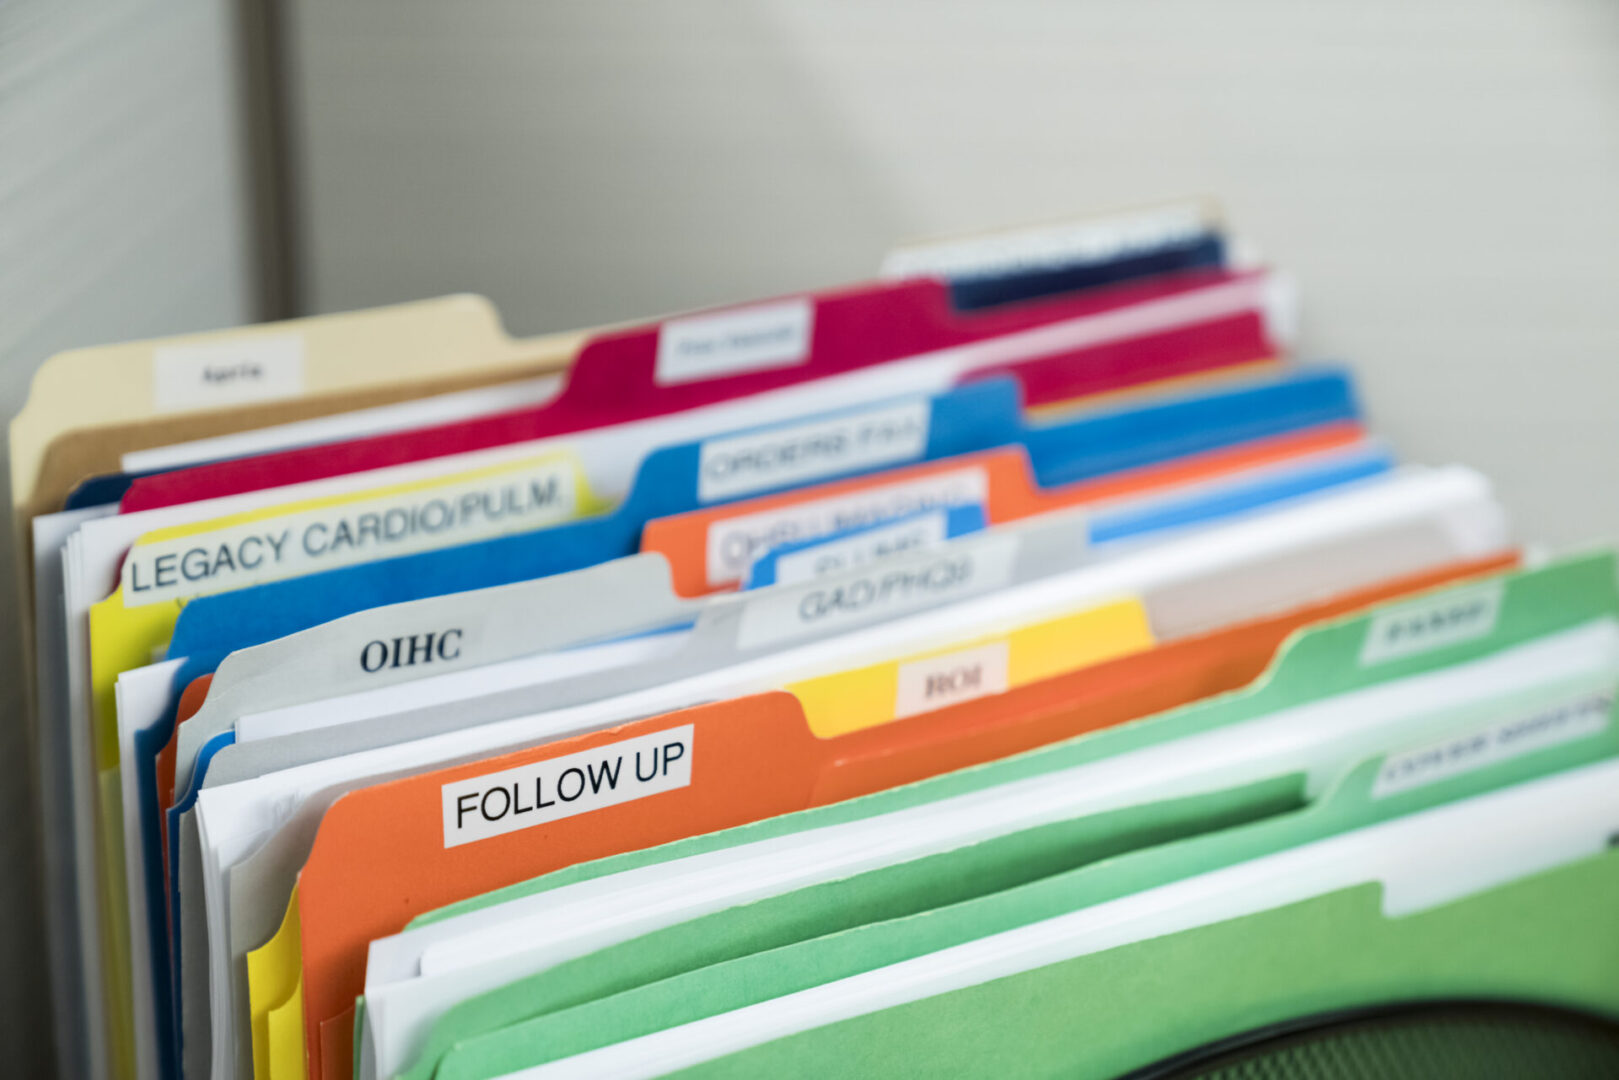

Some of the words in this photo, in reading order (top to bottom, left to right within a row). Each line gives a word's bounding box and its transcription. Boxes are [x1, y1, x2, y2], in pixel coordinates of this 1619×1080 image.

[131, 531, 290, 593] LEGACY
[302, 476, 563, 556] CARDIO/PULM.
[360, 629, 463, 675] OIHC
[924, 665, 982, 699] ROI
[456, 756, 623, 829] FOLLOW
[635, 741, 686, 782] UP
